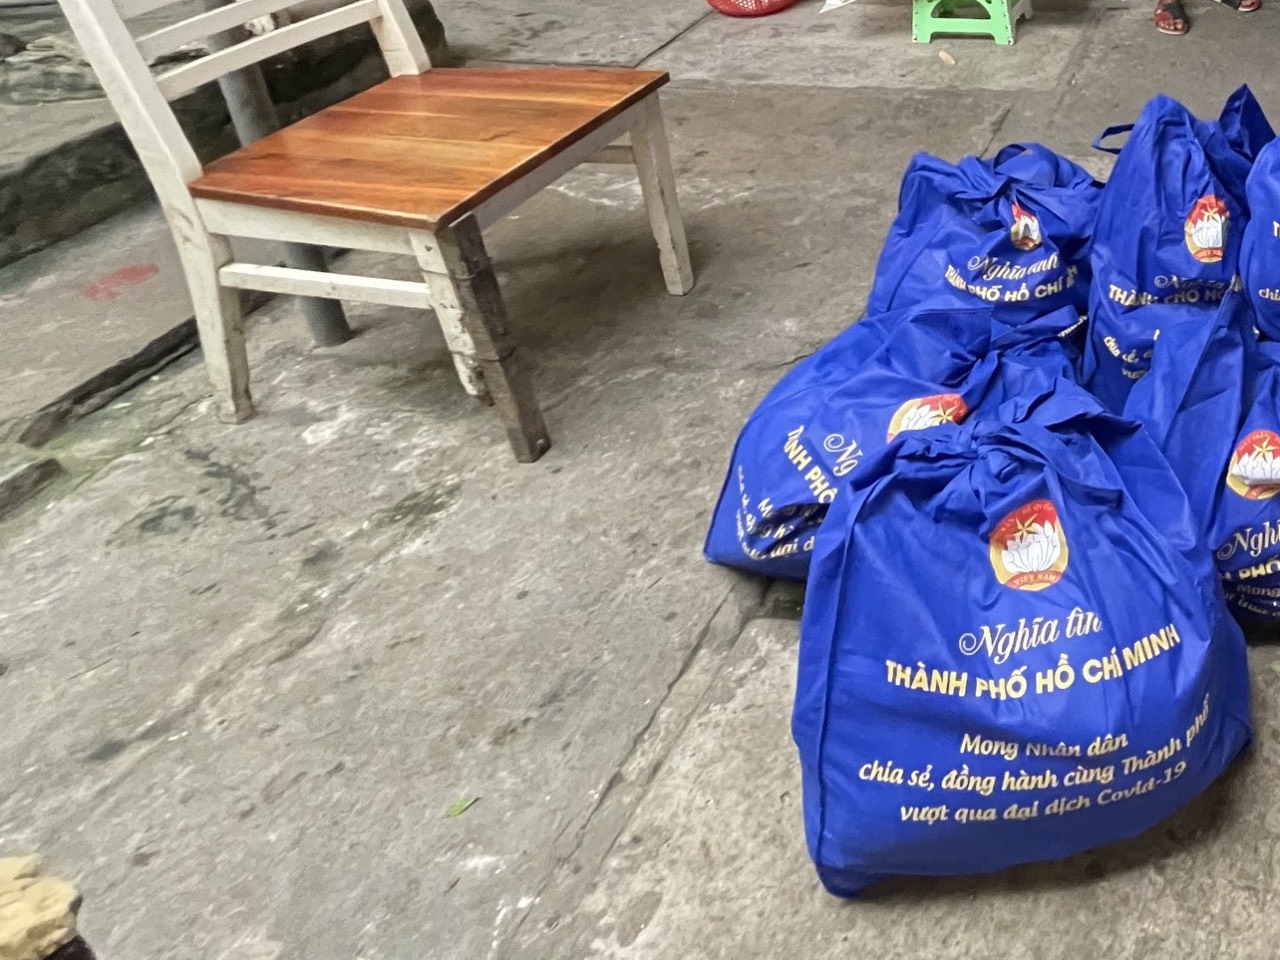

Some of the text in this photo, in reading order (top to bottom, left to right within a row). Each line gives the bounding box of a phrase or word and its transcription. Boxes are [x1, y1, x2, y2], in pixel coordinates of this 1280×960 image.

[885, 622, 1181, 701] THÀNH PHỐ HỒ CHÍ MINH
[958, 616, 1060, 665] Nghĩa
[859, 761, 904, 786] chia
[941, 764, 996, 796] đồng
[1001, 765, 1059, 792] hành
[1063, 763, 1115, 788] cùng
[1122, 738, 1182, 775] Thành
[960, 733, 1129, 761] Mong Nhân dân
[954, 806, 998, 825] qua
[1097, 761, 1187, 805] Covid-19
